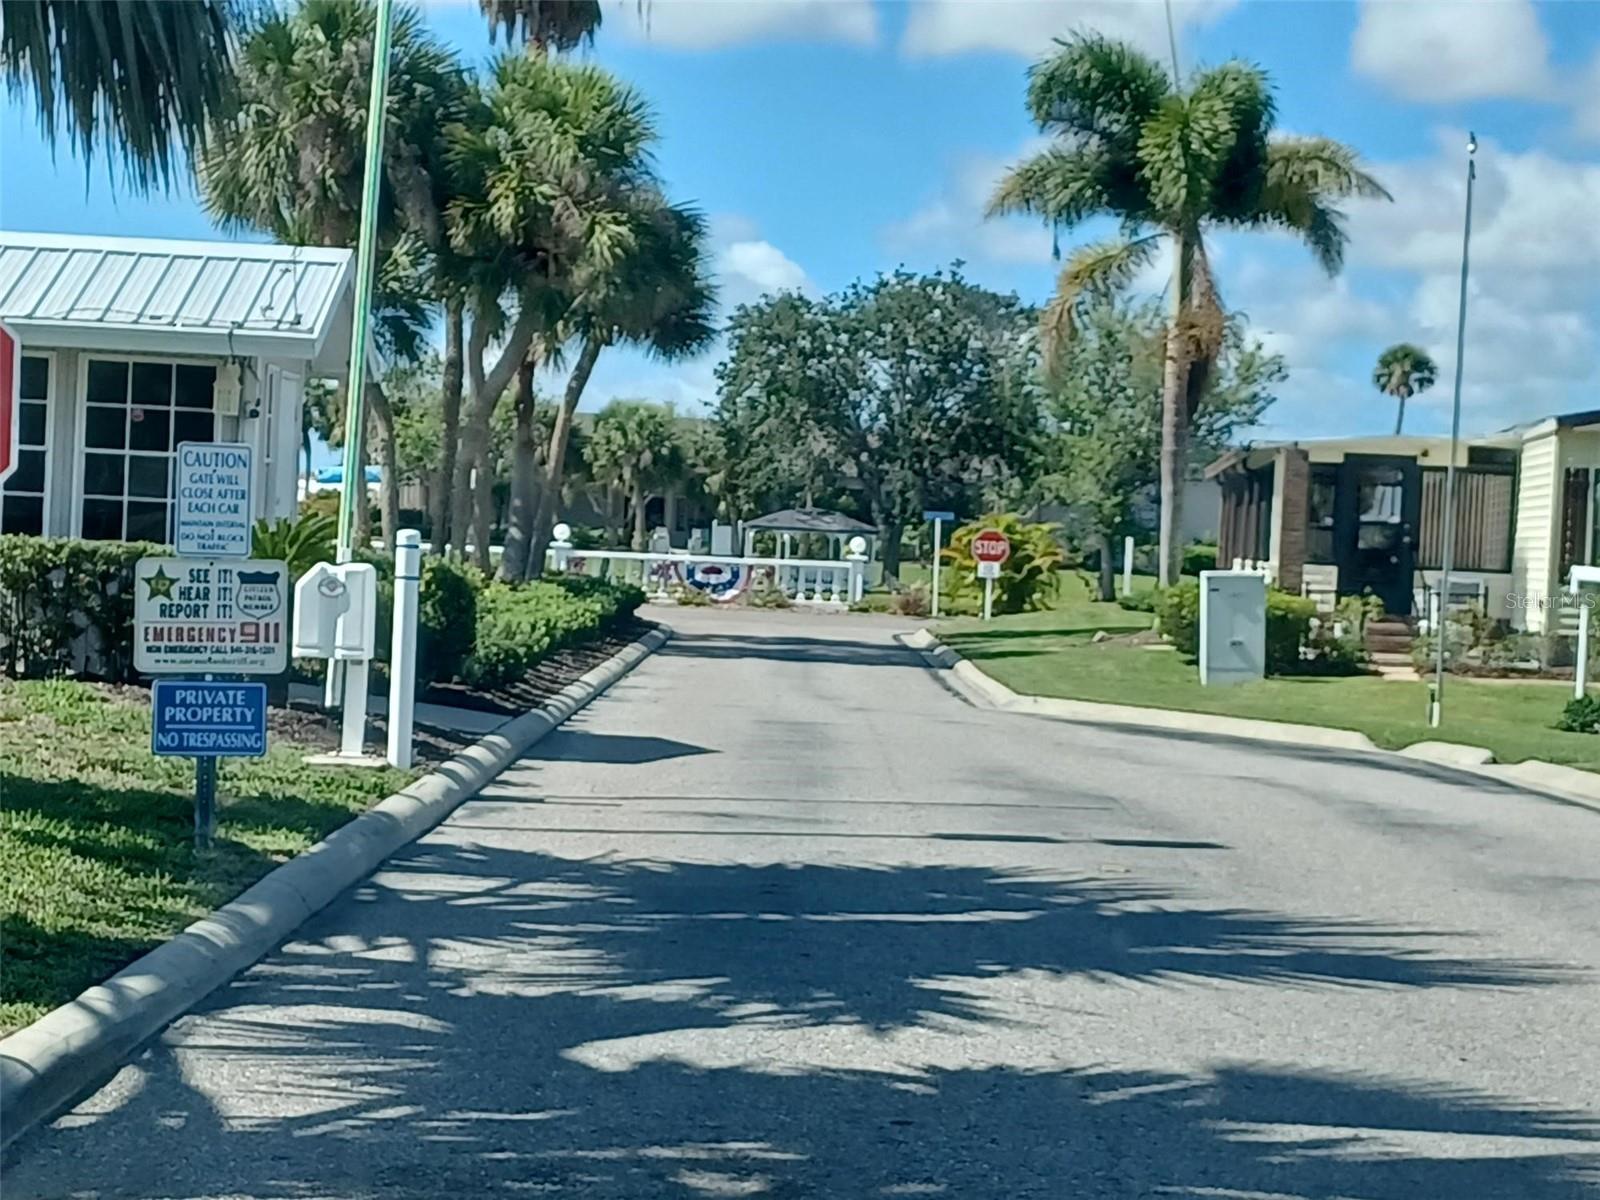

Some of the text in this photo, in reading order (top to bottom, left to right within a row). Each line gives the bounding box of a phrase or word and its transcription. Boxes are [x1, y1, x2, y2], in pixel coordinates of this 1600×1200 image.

[184, 451, 248, 469] CAUTION
[190, 473, 239, 485] GATE WILL
[182, 488, 246, 500] CLOSE AFTER
[188, 502, 240, 514] EACH CAR
[181, 532, 194, 540] DO
[975, 540, 1006, 555] STOP
[189, 569, 232, 584] SEE IT!
[179, 586, 232, 601] HEAR IT!
[160, 604, 232, 619] REPORT IT!
[144, 622, 280, 643] EMERGENCY 911
[164, 645, 207, 654] EMERGENCY
[210, 645, 228, 654] CALL
[175, 690, 246, 705] PRIVATE
[165, 706, 255, 722] PROPERTY
[158, 732, 261, 748] NO TRESPASSING
